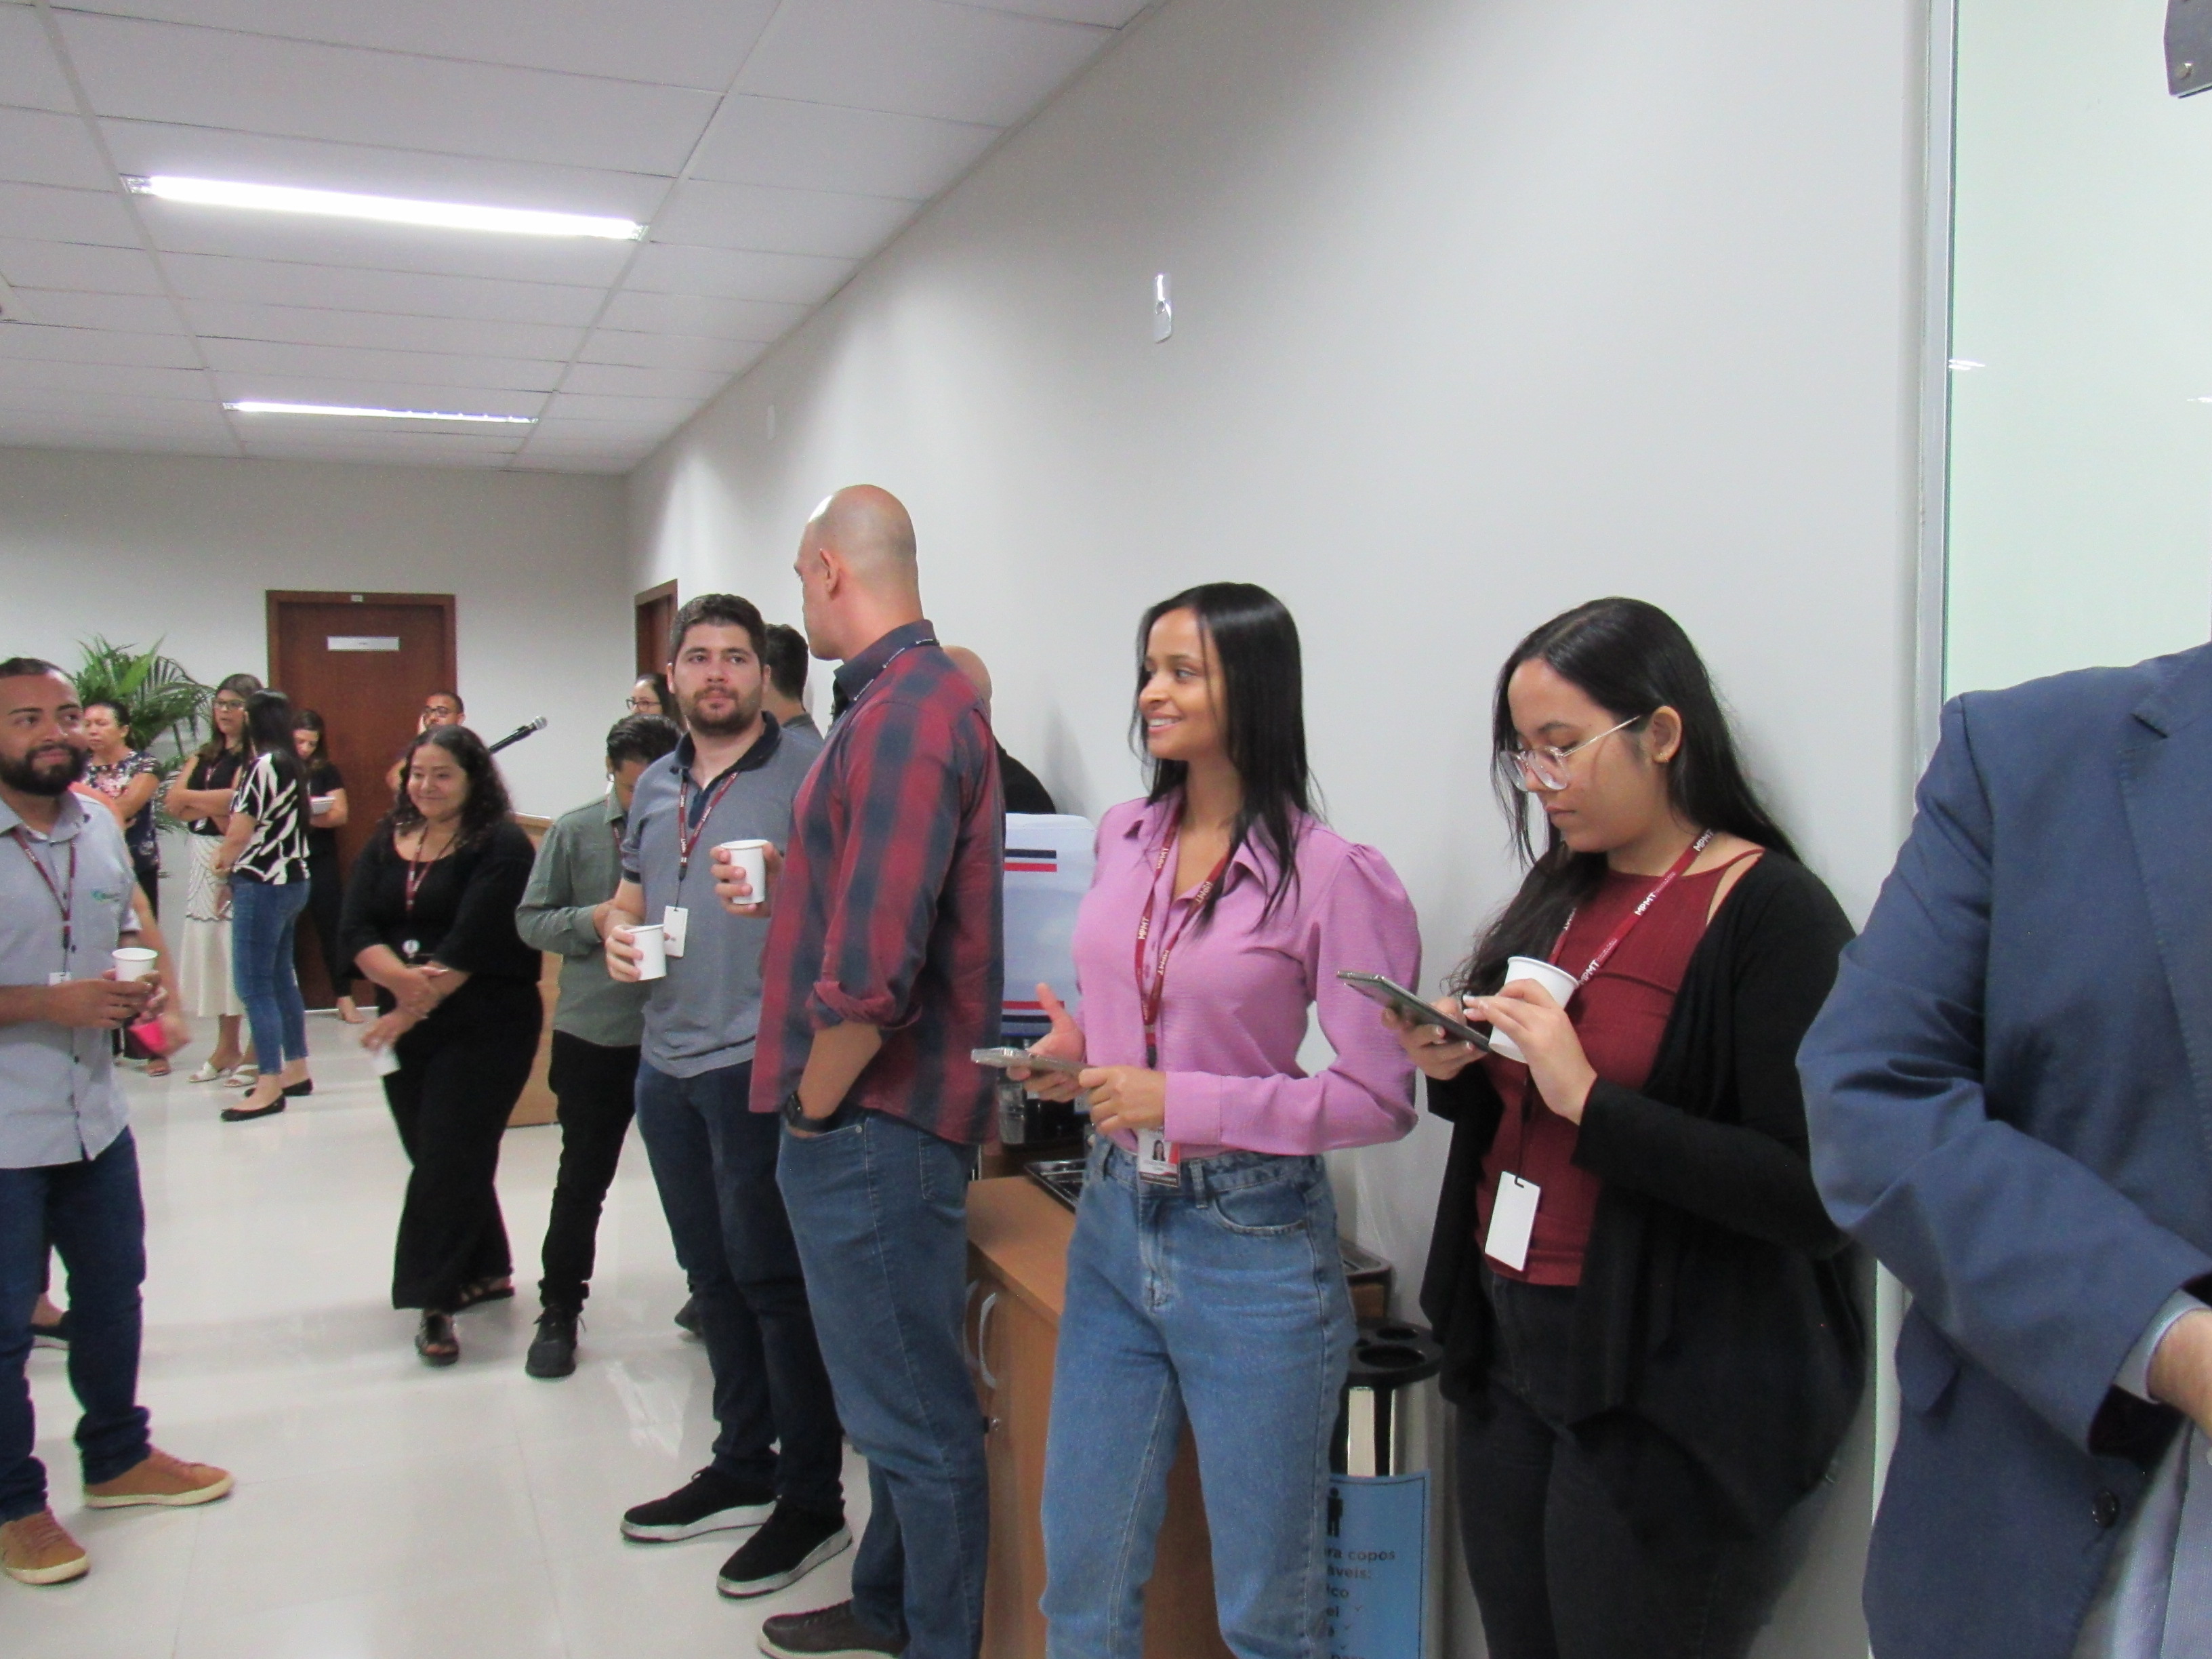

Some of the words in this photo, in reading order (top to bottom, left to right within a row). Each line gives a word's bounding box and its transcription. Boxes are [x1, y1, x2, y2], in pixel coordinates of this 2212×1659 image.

[1693, 828, 1713, 852] MPMT
[1158, 848, 1169, 868] MPMT
[1195, 881, 1214, 903] MPMT
[1634, 892, 1657, 916] MPMT
[1138, 918, 1149, 939] MPMT
[1158, 950, 1169, 975] MPMT
[1324, 1548, 1342, 1559] ra
[1348, 1551, 1395, 1562] copos
[1326, 1605, 1339, 1618] el
